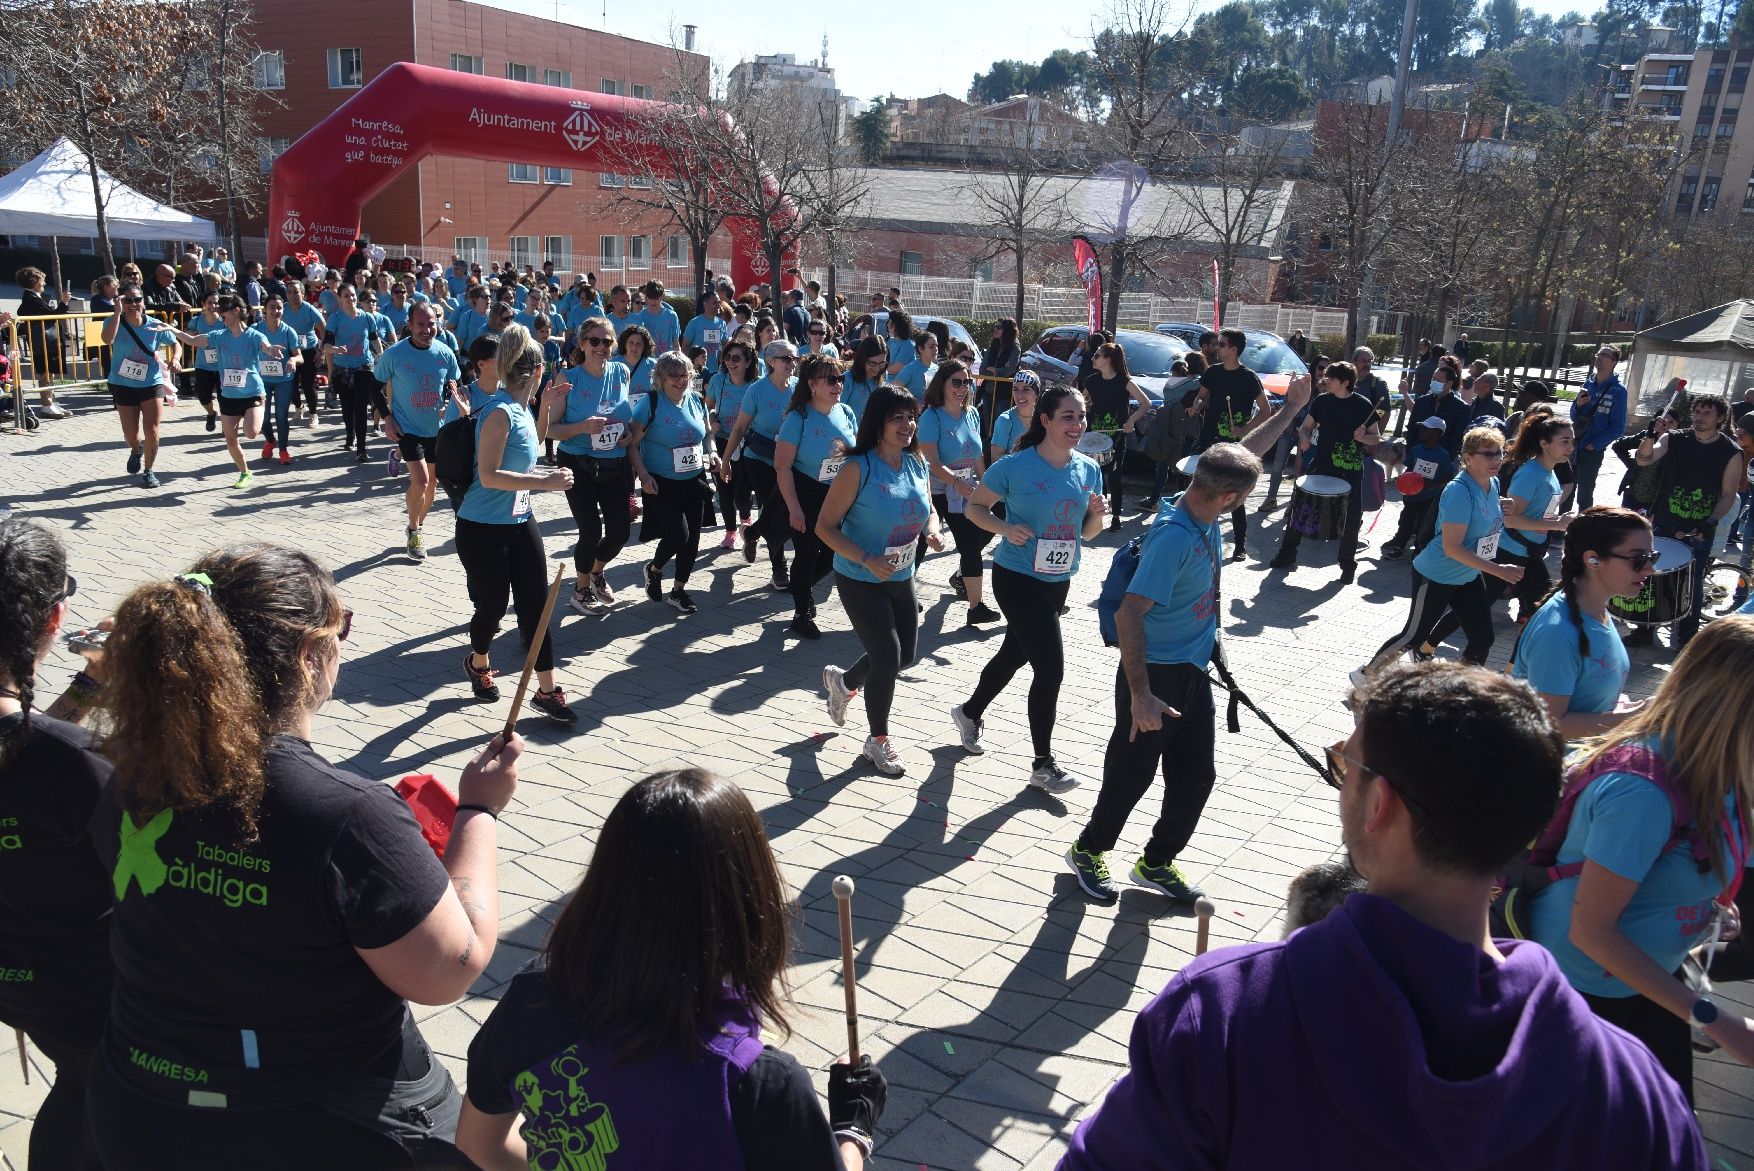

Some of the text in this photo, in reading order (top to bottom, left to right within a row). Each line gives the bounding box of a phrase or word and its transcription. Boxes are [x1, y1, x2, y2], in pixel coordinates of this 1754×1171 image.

[351, 118, 404, 134] Manresa,
[468, 107, 556, 134] Ajuntament
[605, 127, 623, 142] de
[345, 134, 409, 151] una ciutat
[345, 150, 403, 168] que batega
[308, 234, 321, 244] de
[126, 365, 143, 376] 118
[228, 374, 242, 382] 119
[598, 432, 620, 445] 417
[1418, 464, 1432, 474] 745
[1045, 550, 1070, 566] 422
[196, 840, 271, 873] Tabalers
